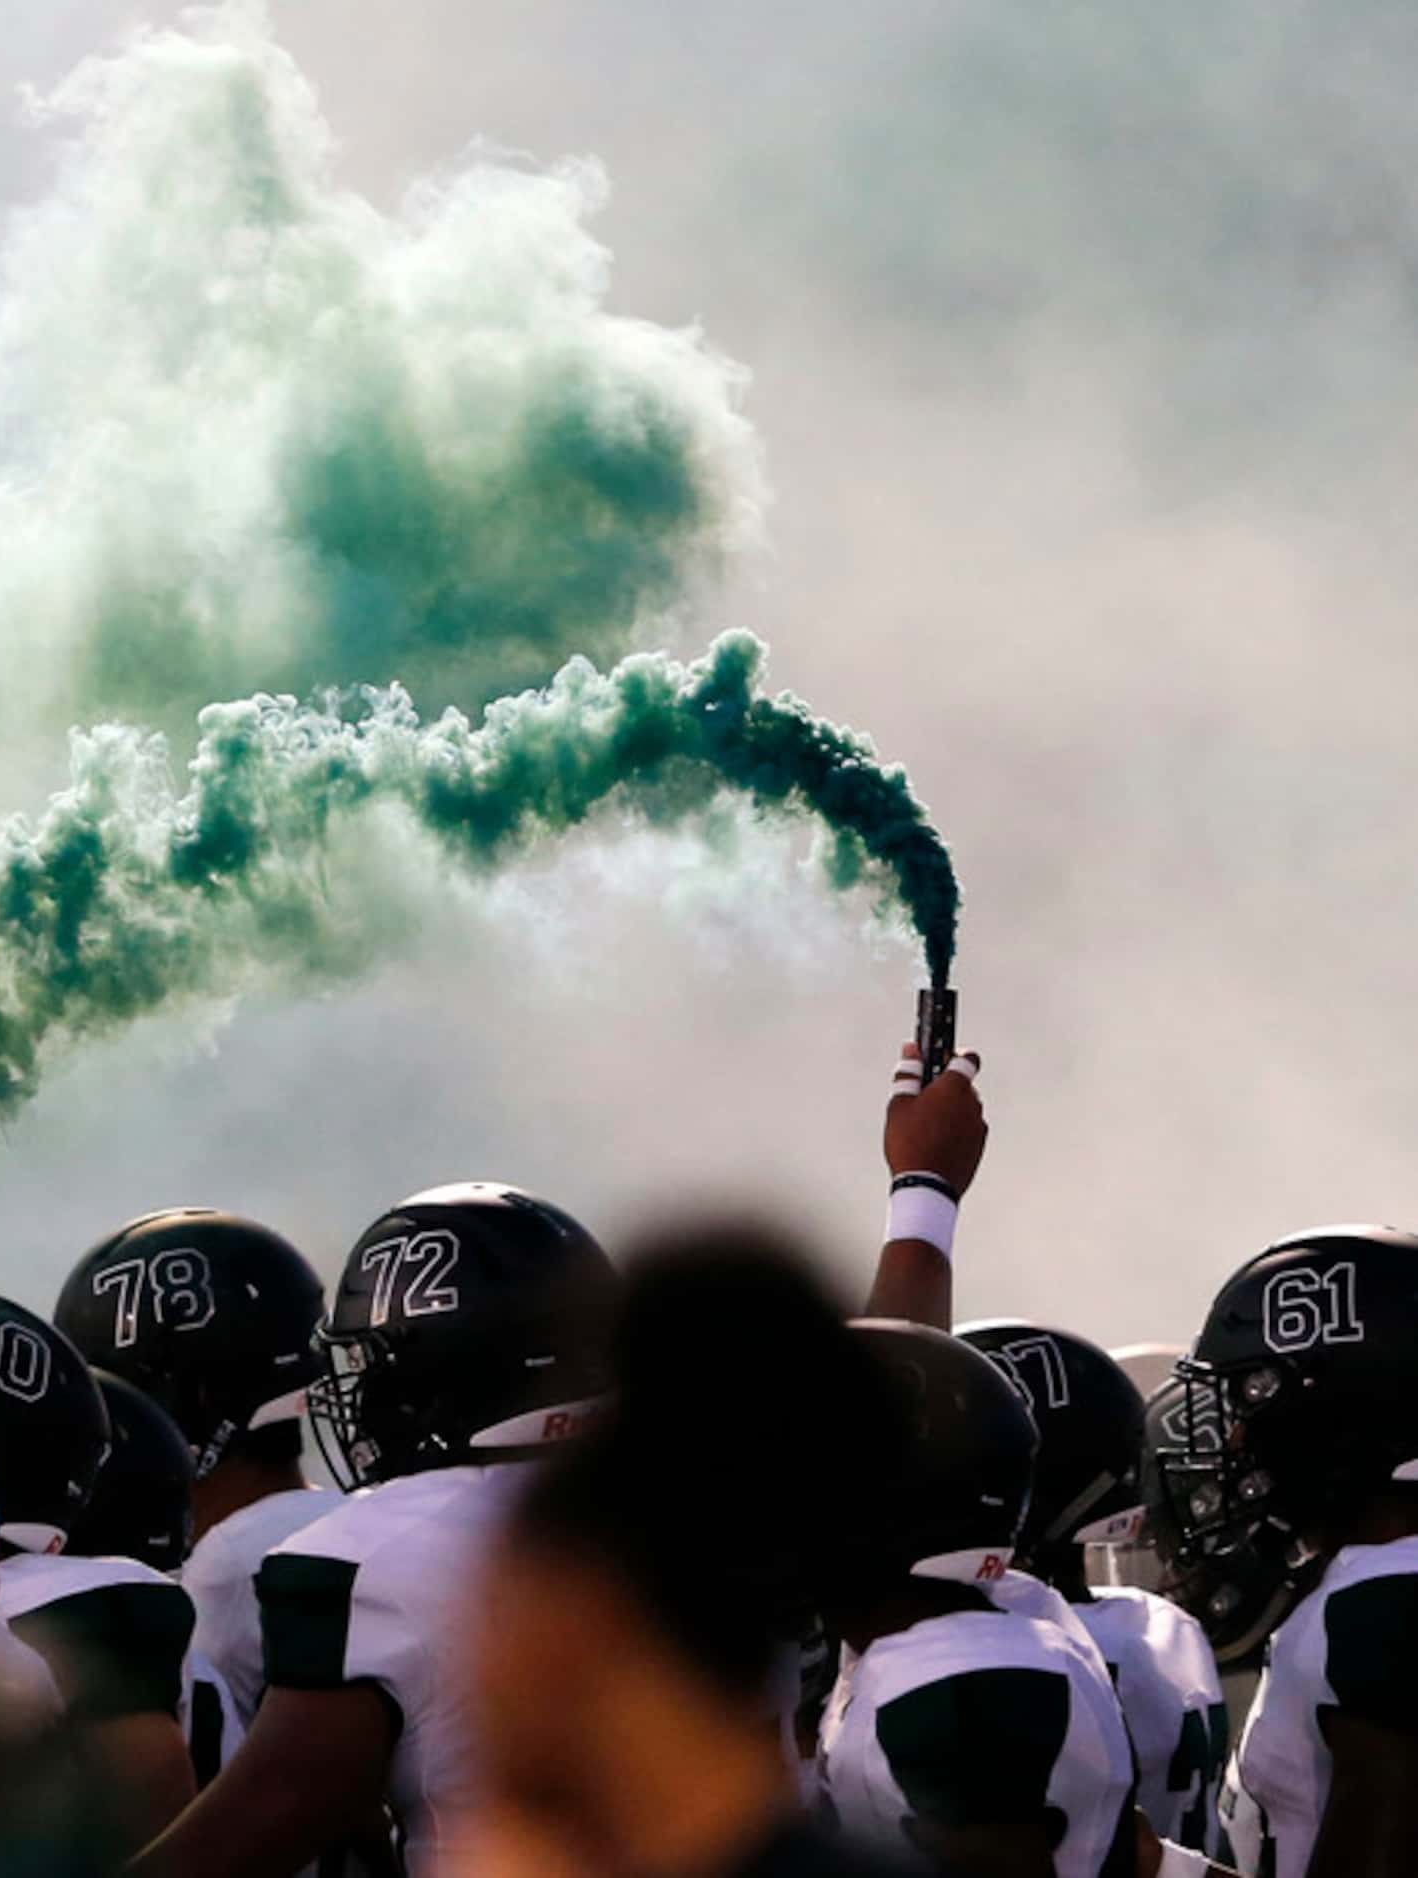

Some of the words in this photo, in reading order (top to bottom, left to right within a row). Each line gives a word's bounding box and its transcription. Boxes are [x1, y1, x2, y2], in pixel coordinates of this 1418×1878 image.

[92, 1247, 215, 1348] 78
[361, 1228, 459, 1325] 72
[1262, 1262, 1365, 1353] 61
[985, 1334, 1070, 1408] 7
